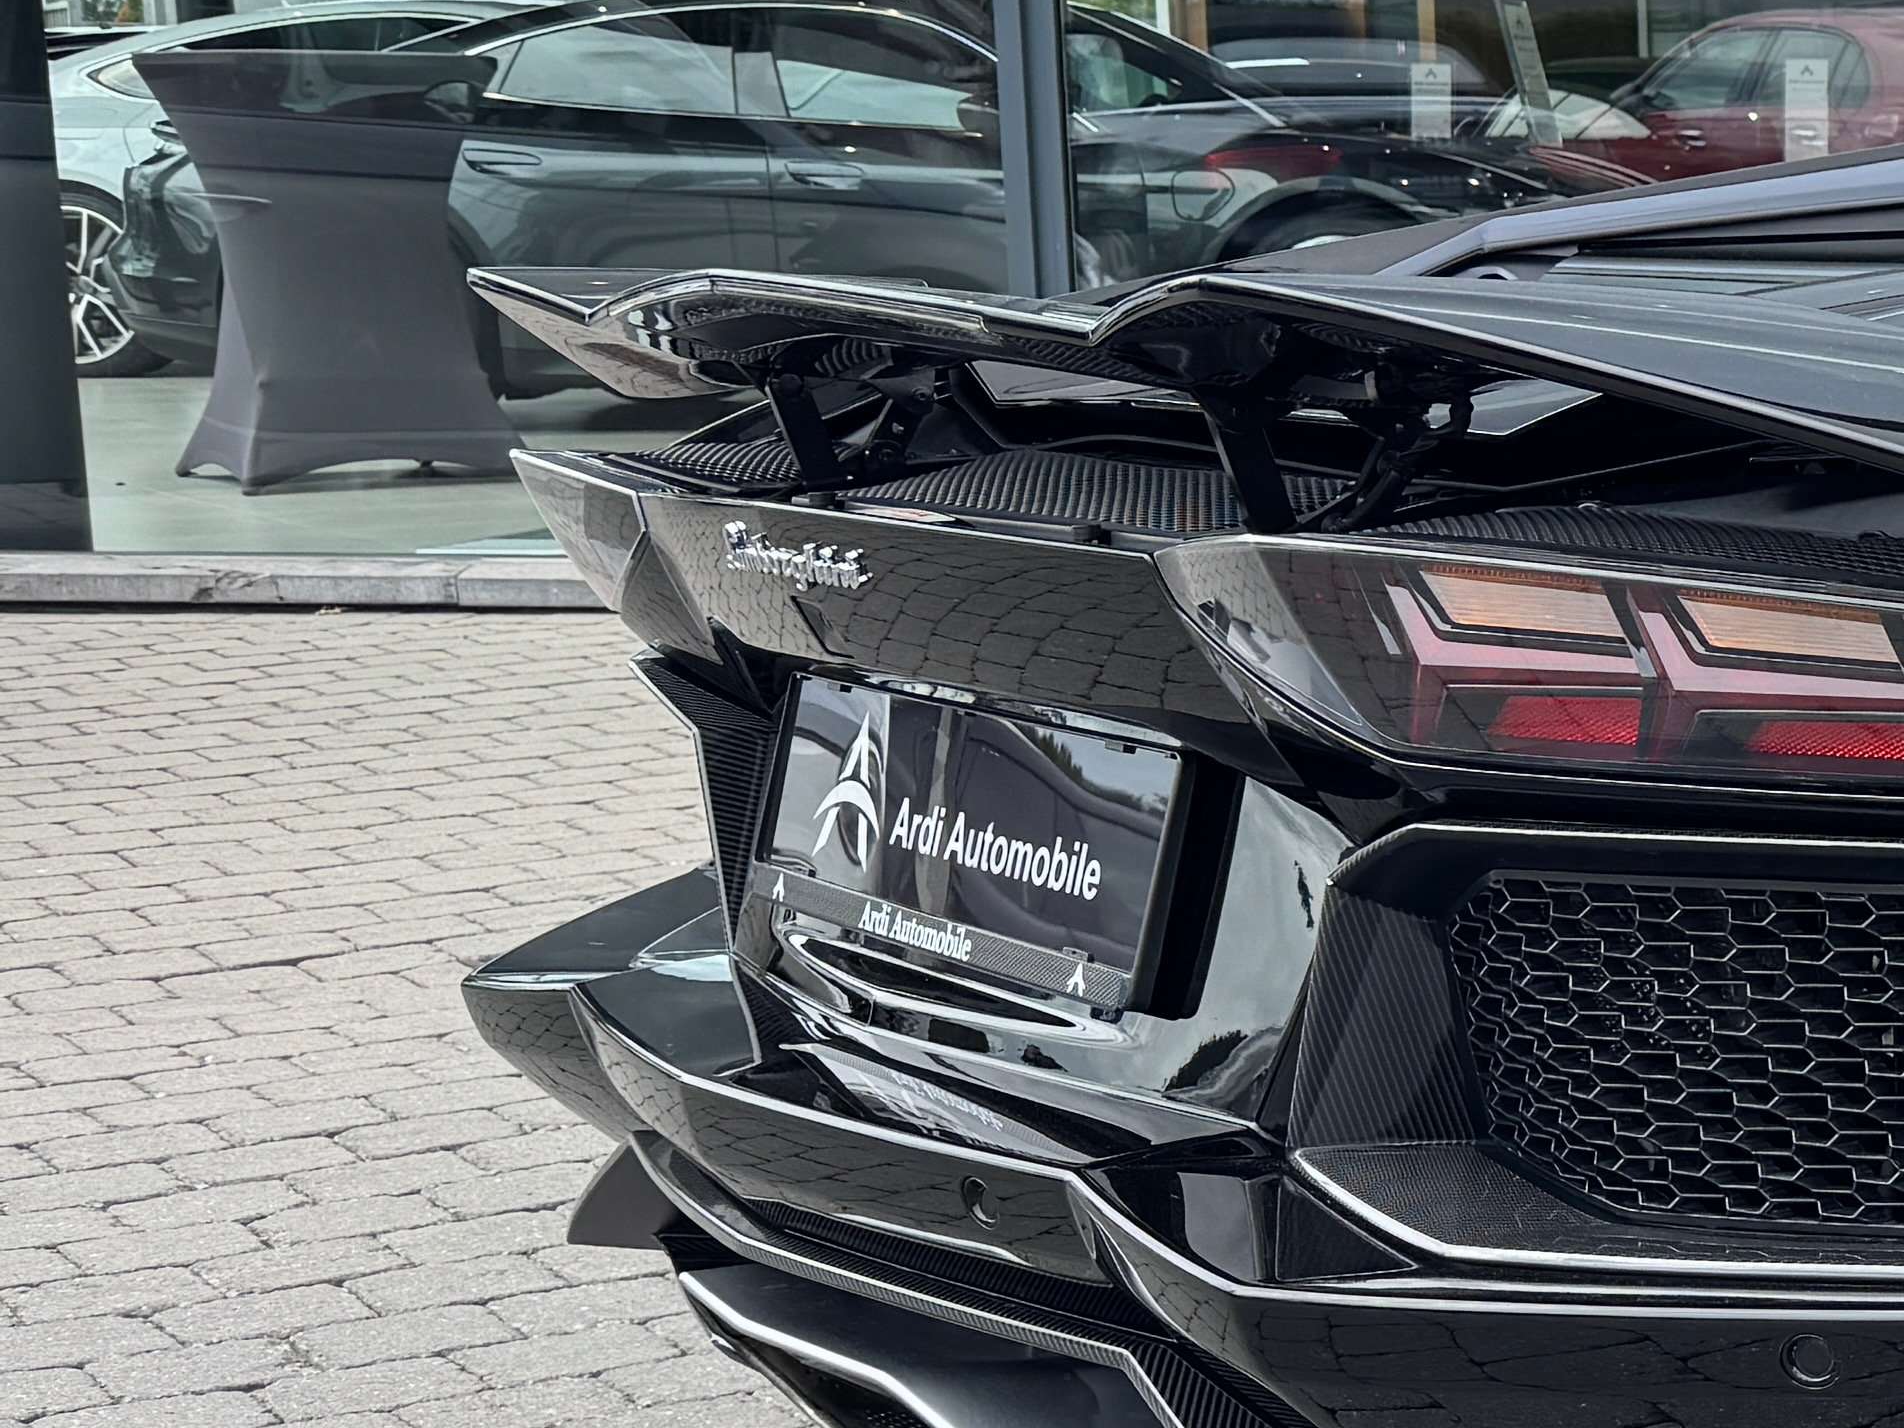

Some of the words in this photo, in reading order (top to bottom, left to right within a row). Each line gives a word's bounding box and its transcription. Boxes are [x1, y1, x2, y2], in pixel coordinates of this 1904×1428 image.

[889, 797, 947, 858] Ardi
[943, 810, 1101, 902] Automobile
[858, 901, 890, 934] Ardi
[888, 913, 972, 963] Automobile
